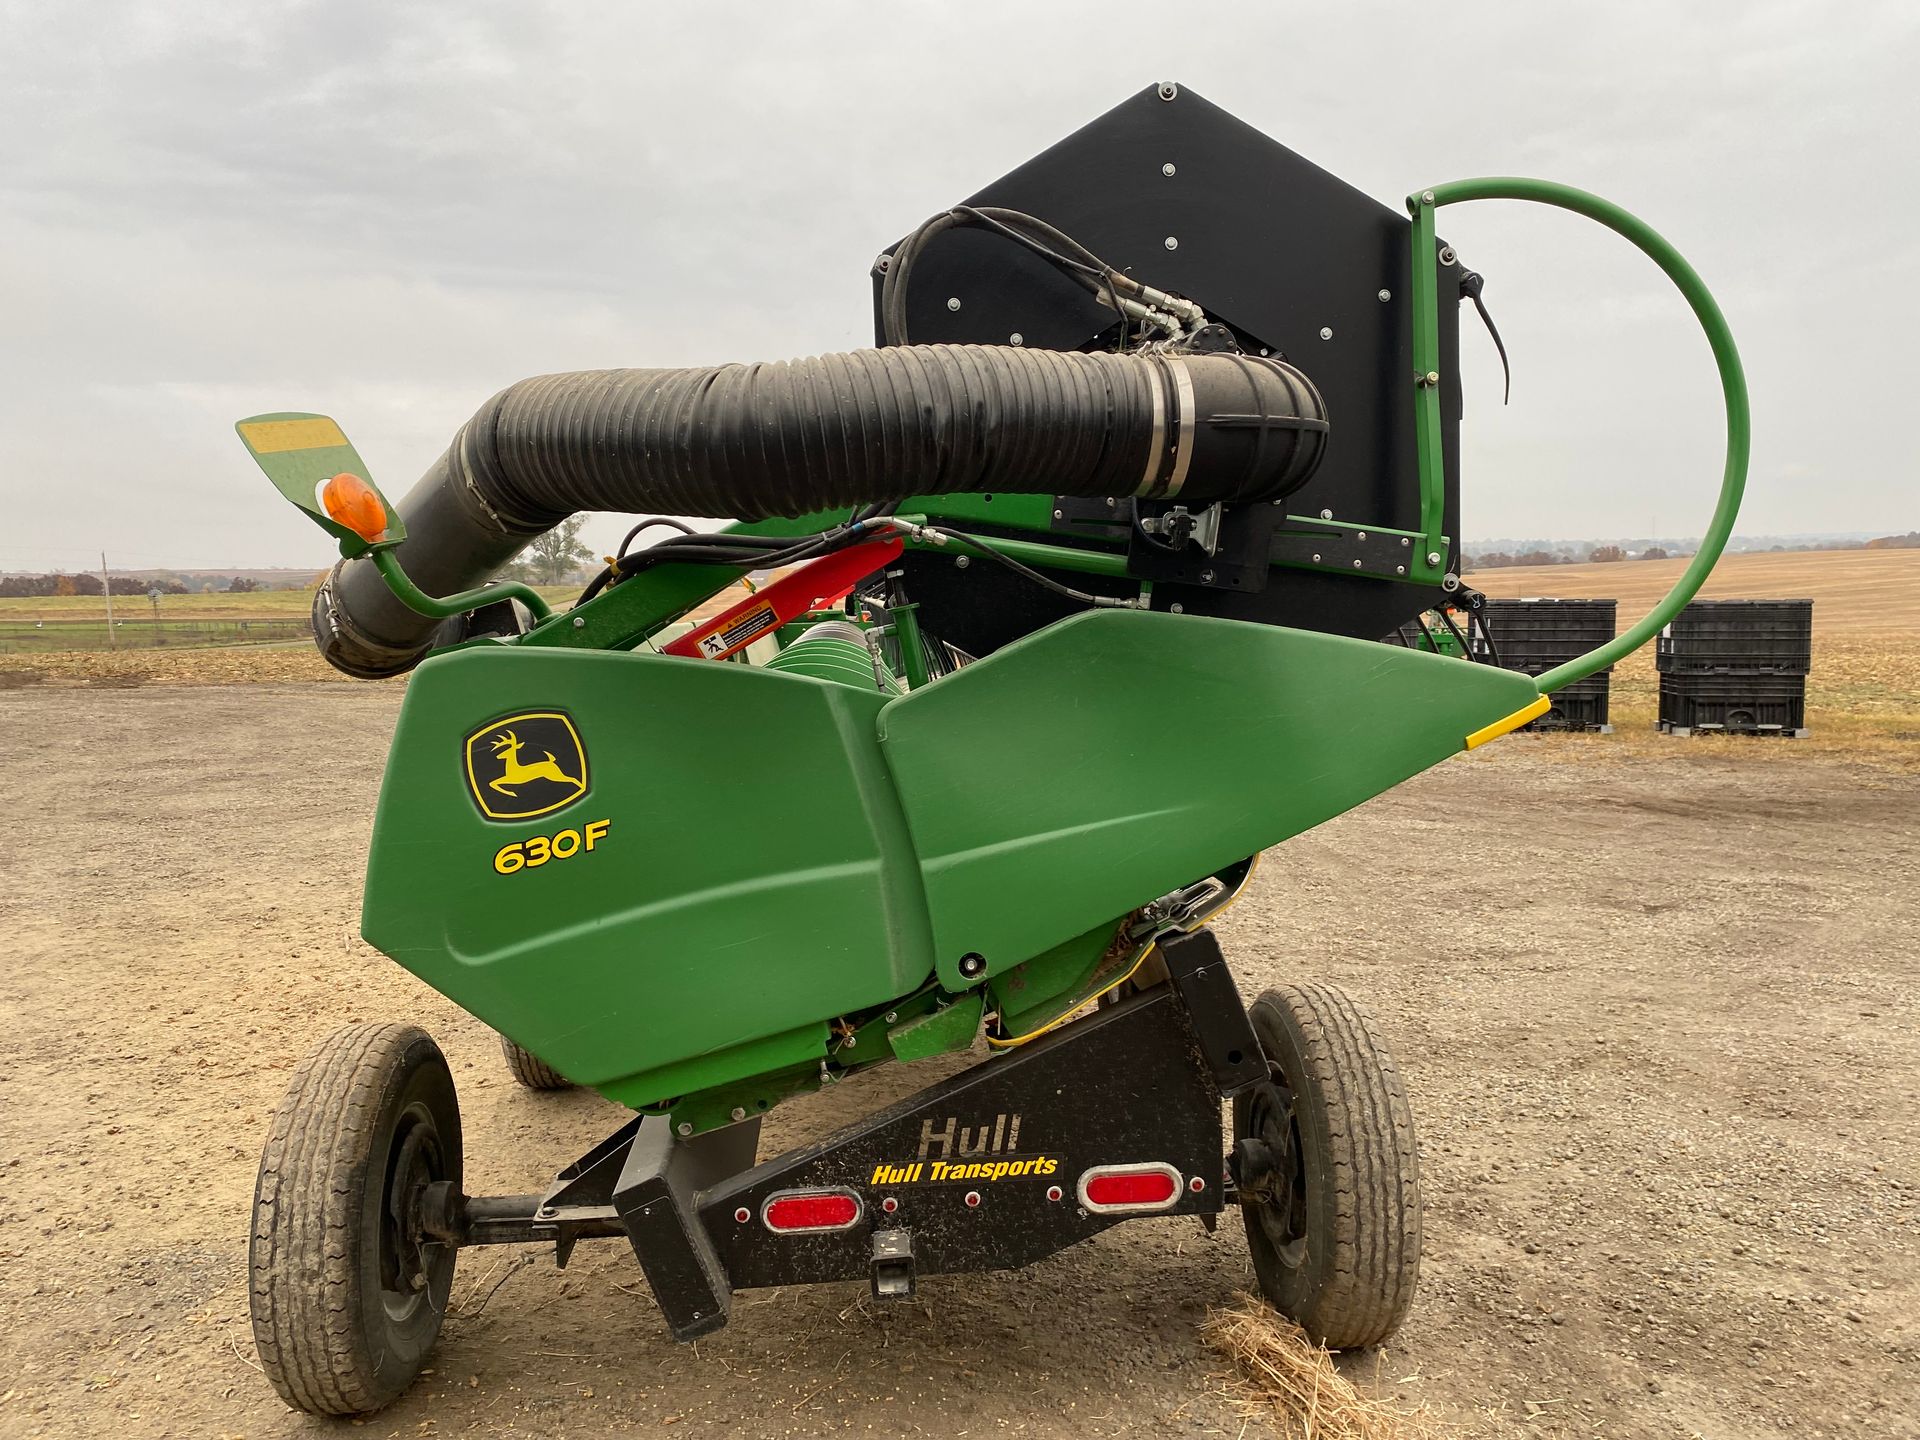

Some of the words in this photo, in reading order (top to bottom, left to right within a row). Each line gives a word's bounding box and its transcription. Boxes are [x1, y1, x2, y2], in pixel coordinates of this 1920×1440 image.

[734, 605, 762, 624] WARNING
[494, 818, 611, 874] 630F
[917, 1113, 1022, 1160] Hull
[870, 1163, 923, 1185] Hull
[930, 1156, 1058, 1181] Transports
